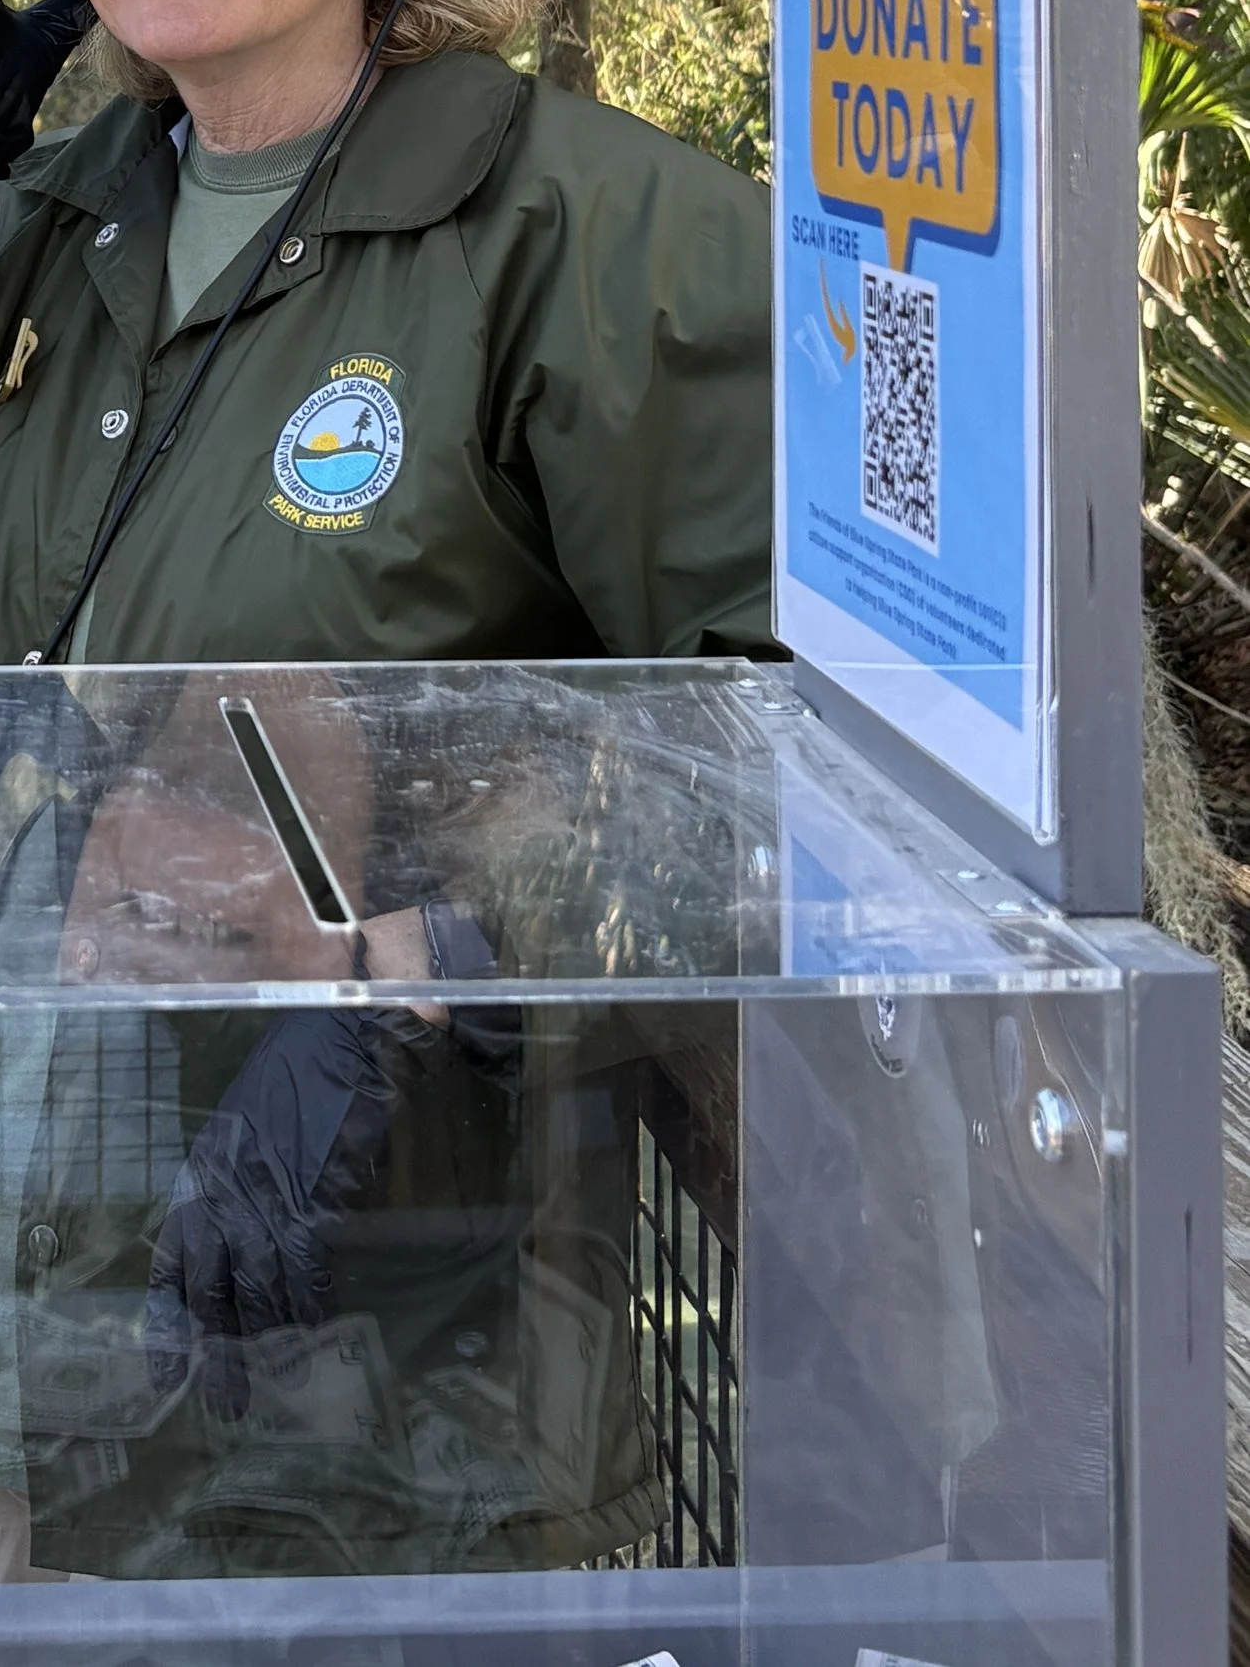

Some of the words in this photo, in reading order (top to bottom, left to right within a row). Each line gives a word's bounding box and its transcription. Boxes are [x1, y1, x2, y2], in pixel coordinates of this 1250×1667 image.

[832, 80, 974, 194] TODAY
[791, 215, 826, 251] SCAN
[828, 225, 860, 261] HERE
[330, 358, 393, 385] FLORIDA
[291, 386, 339, 429] FLORIDA
[341, 380, 399, 424] DEPARTMENT
[388, 425, 401, 445] OF
[333, 452, 400, 510] PROTECTION
[267, 493, 302, 525] PARK
[303, 511, 366, 531] SERVICE
